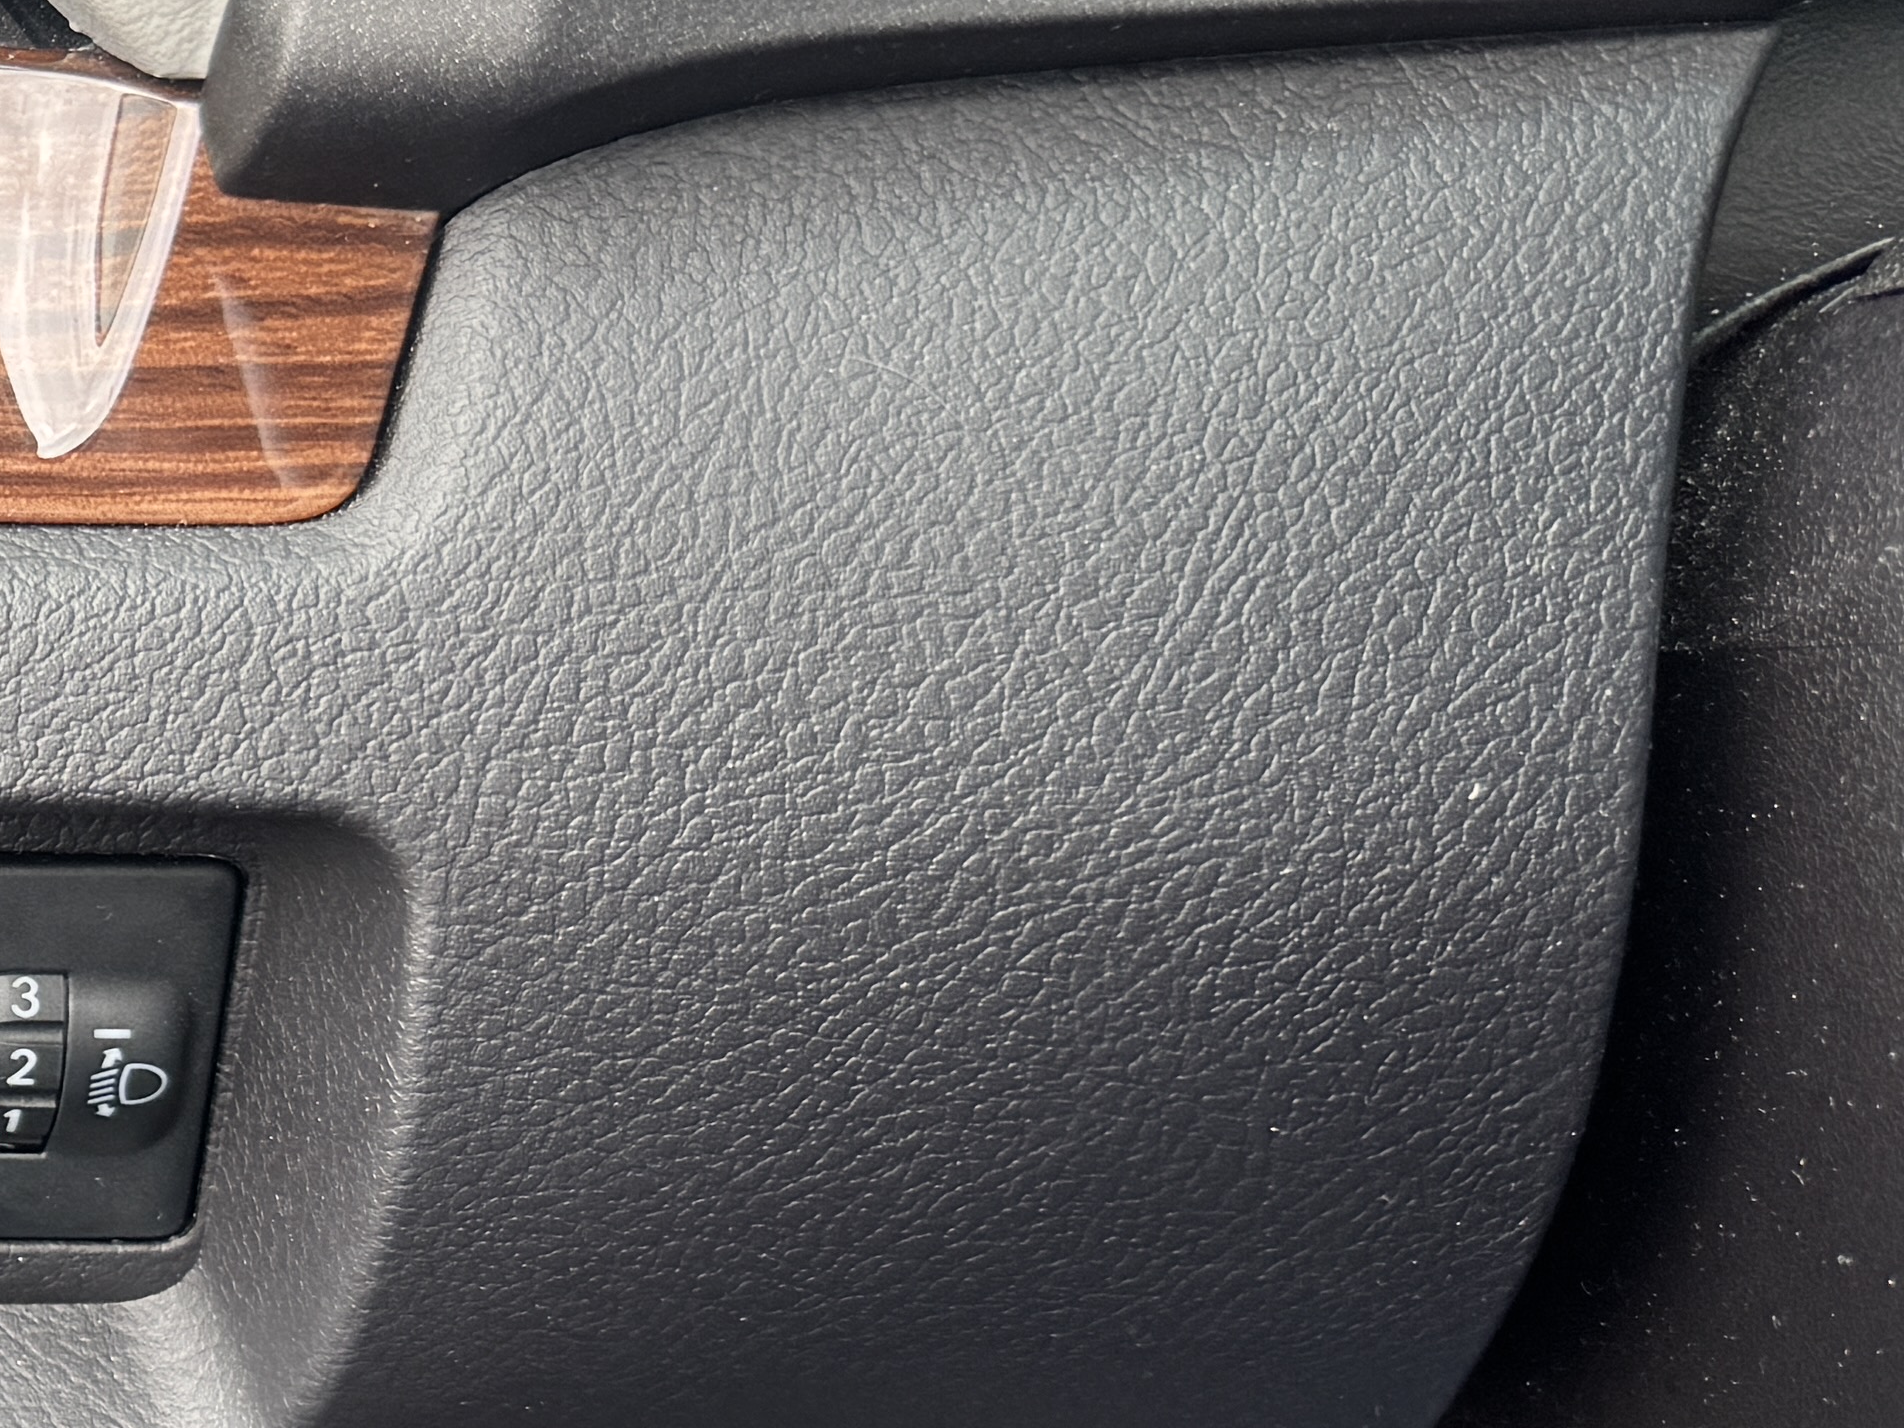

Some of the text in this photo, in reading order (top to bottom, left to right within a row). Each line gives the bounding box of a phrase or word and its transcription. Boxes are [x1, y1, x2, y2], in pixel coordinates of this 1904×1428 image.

[10, 976, 40, 1019] 3
[6, 1049, 36, 1086] 2
[3, 1109, 21, 1133] 1
